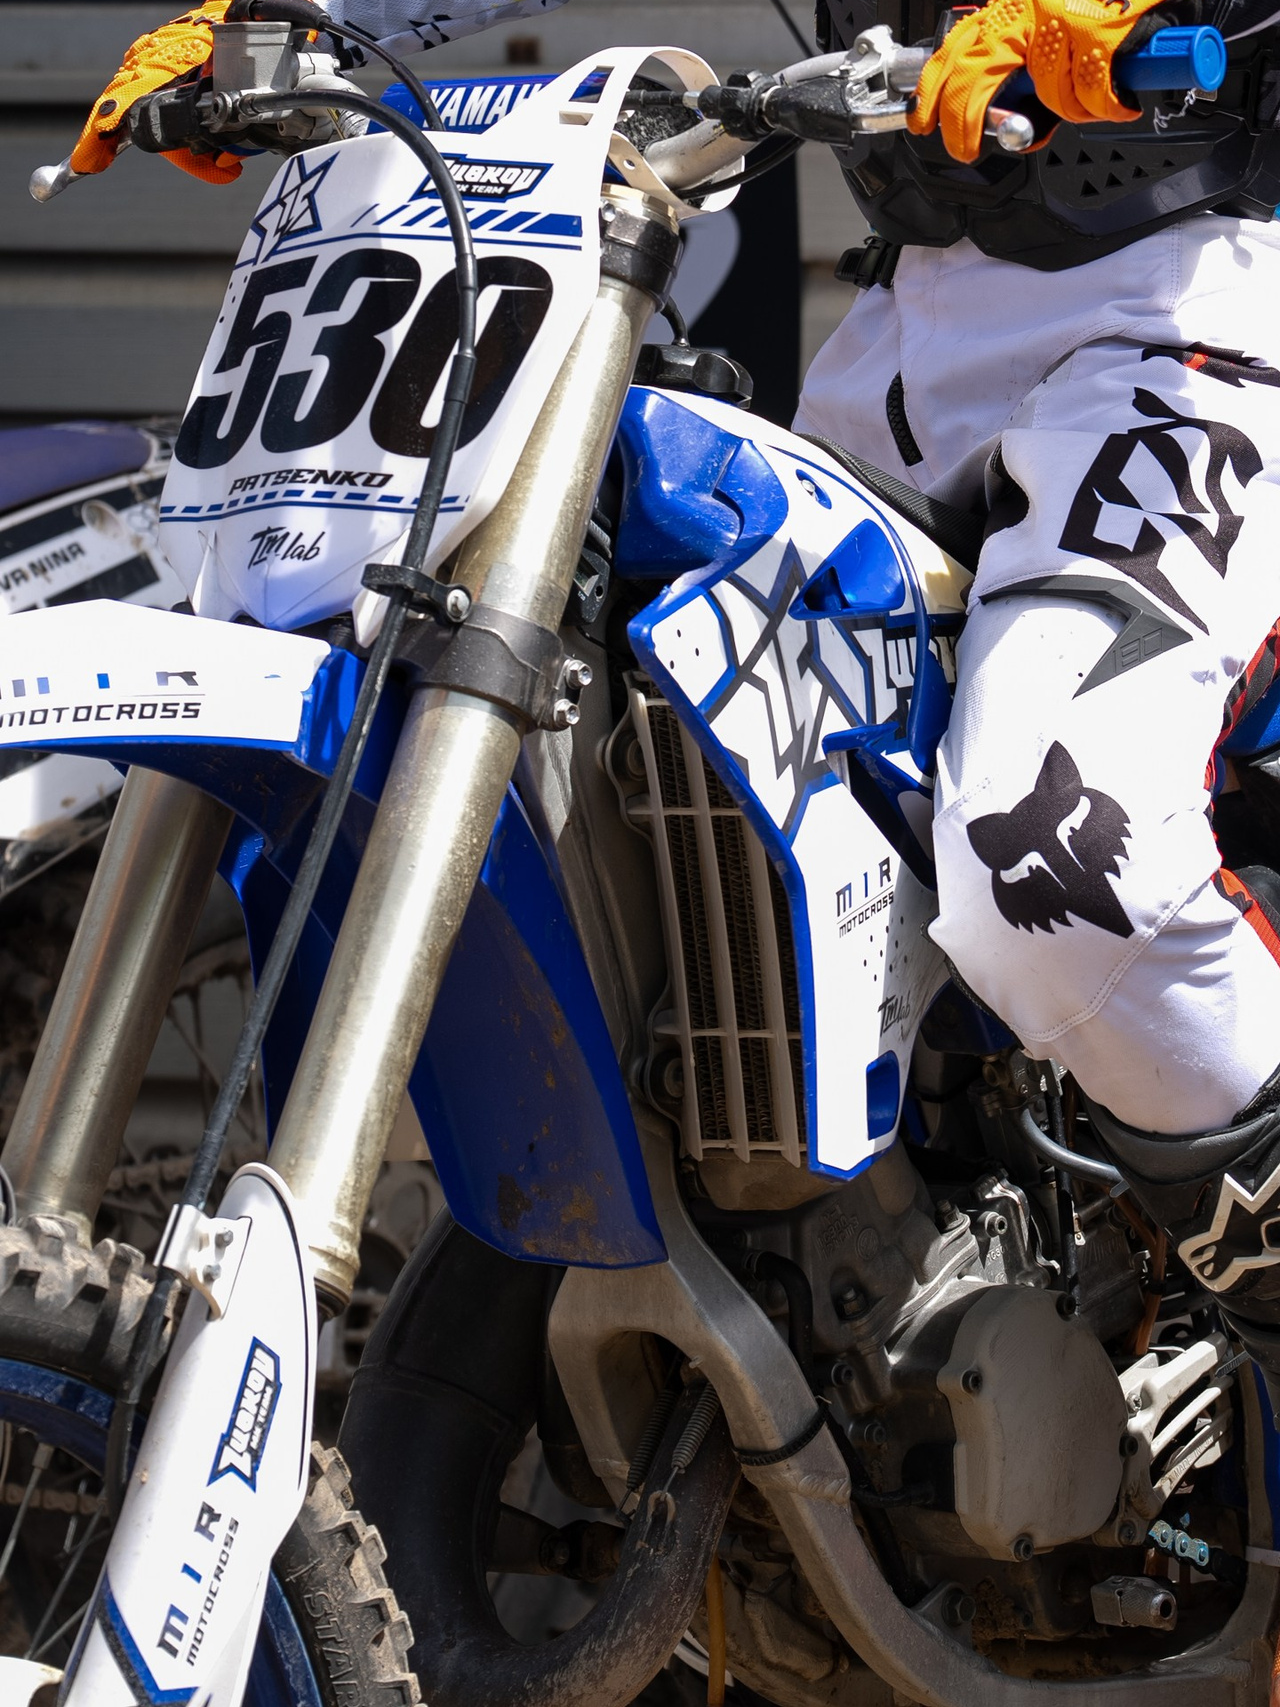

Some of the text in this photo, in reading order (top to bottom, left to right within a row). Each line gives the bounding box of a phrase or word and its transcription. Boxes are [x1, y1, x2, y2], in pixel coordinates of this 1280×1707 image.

[422, 82, 543, 128] YAMA
[470, 183, 505, 195] TEAM
[174, 247, 554, 470] 530
[229, 468, 394, 496] PATSENKO
[0, 702, 201, 729] MOTOCROSS
[839, 890, 895, 939] MOTOCROSS
[185, 1516, 240, 1667] MOTOCROSS
